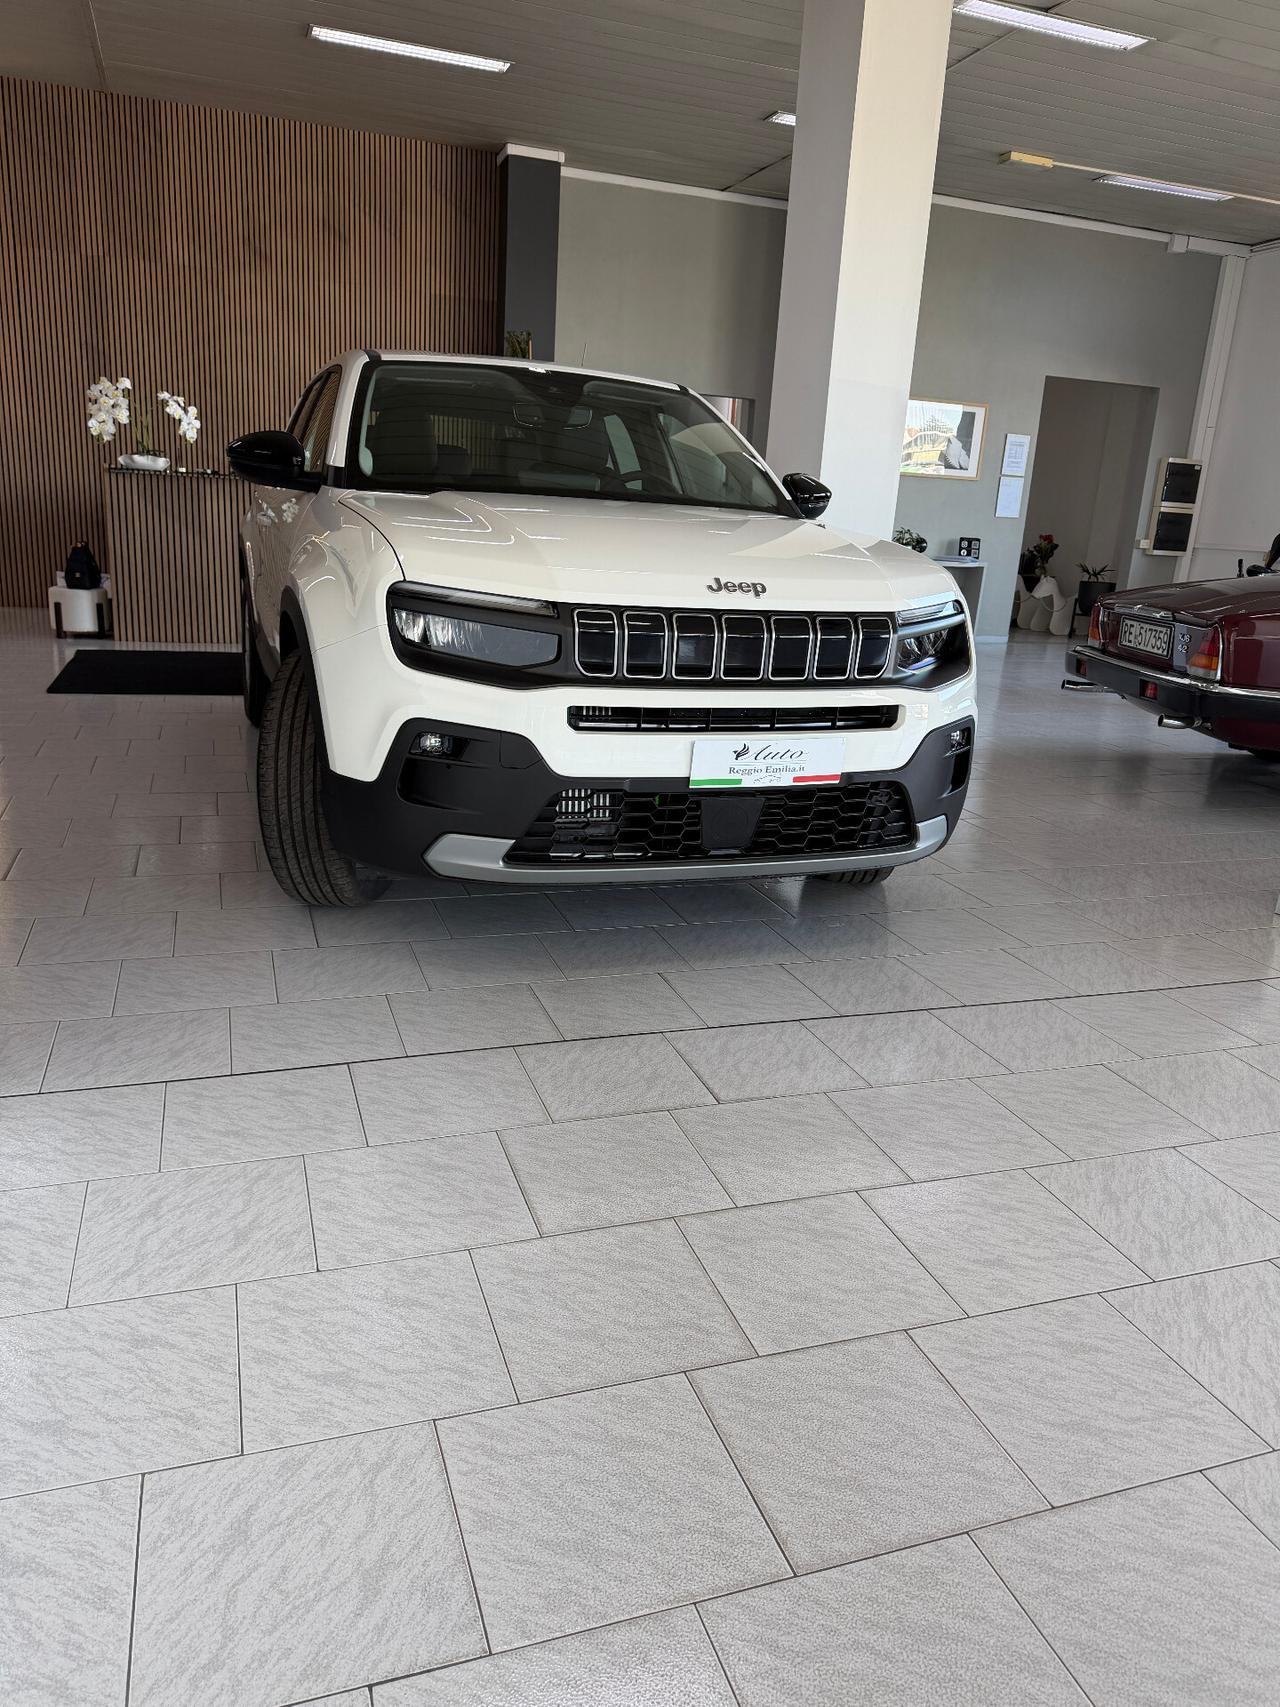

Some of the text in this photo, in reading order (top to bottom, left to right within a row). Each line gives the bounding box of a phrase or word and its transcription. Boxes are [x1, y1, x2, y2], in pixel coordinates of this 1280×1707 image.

[707, 577, 767, 598] Jeep
[1122, 623, 1135, 643] RE
[728, 765, 805, 776] Reggio Emilia.it
